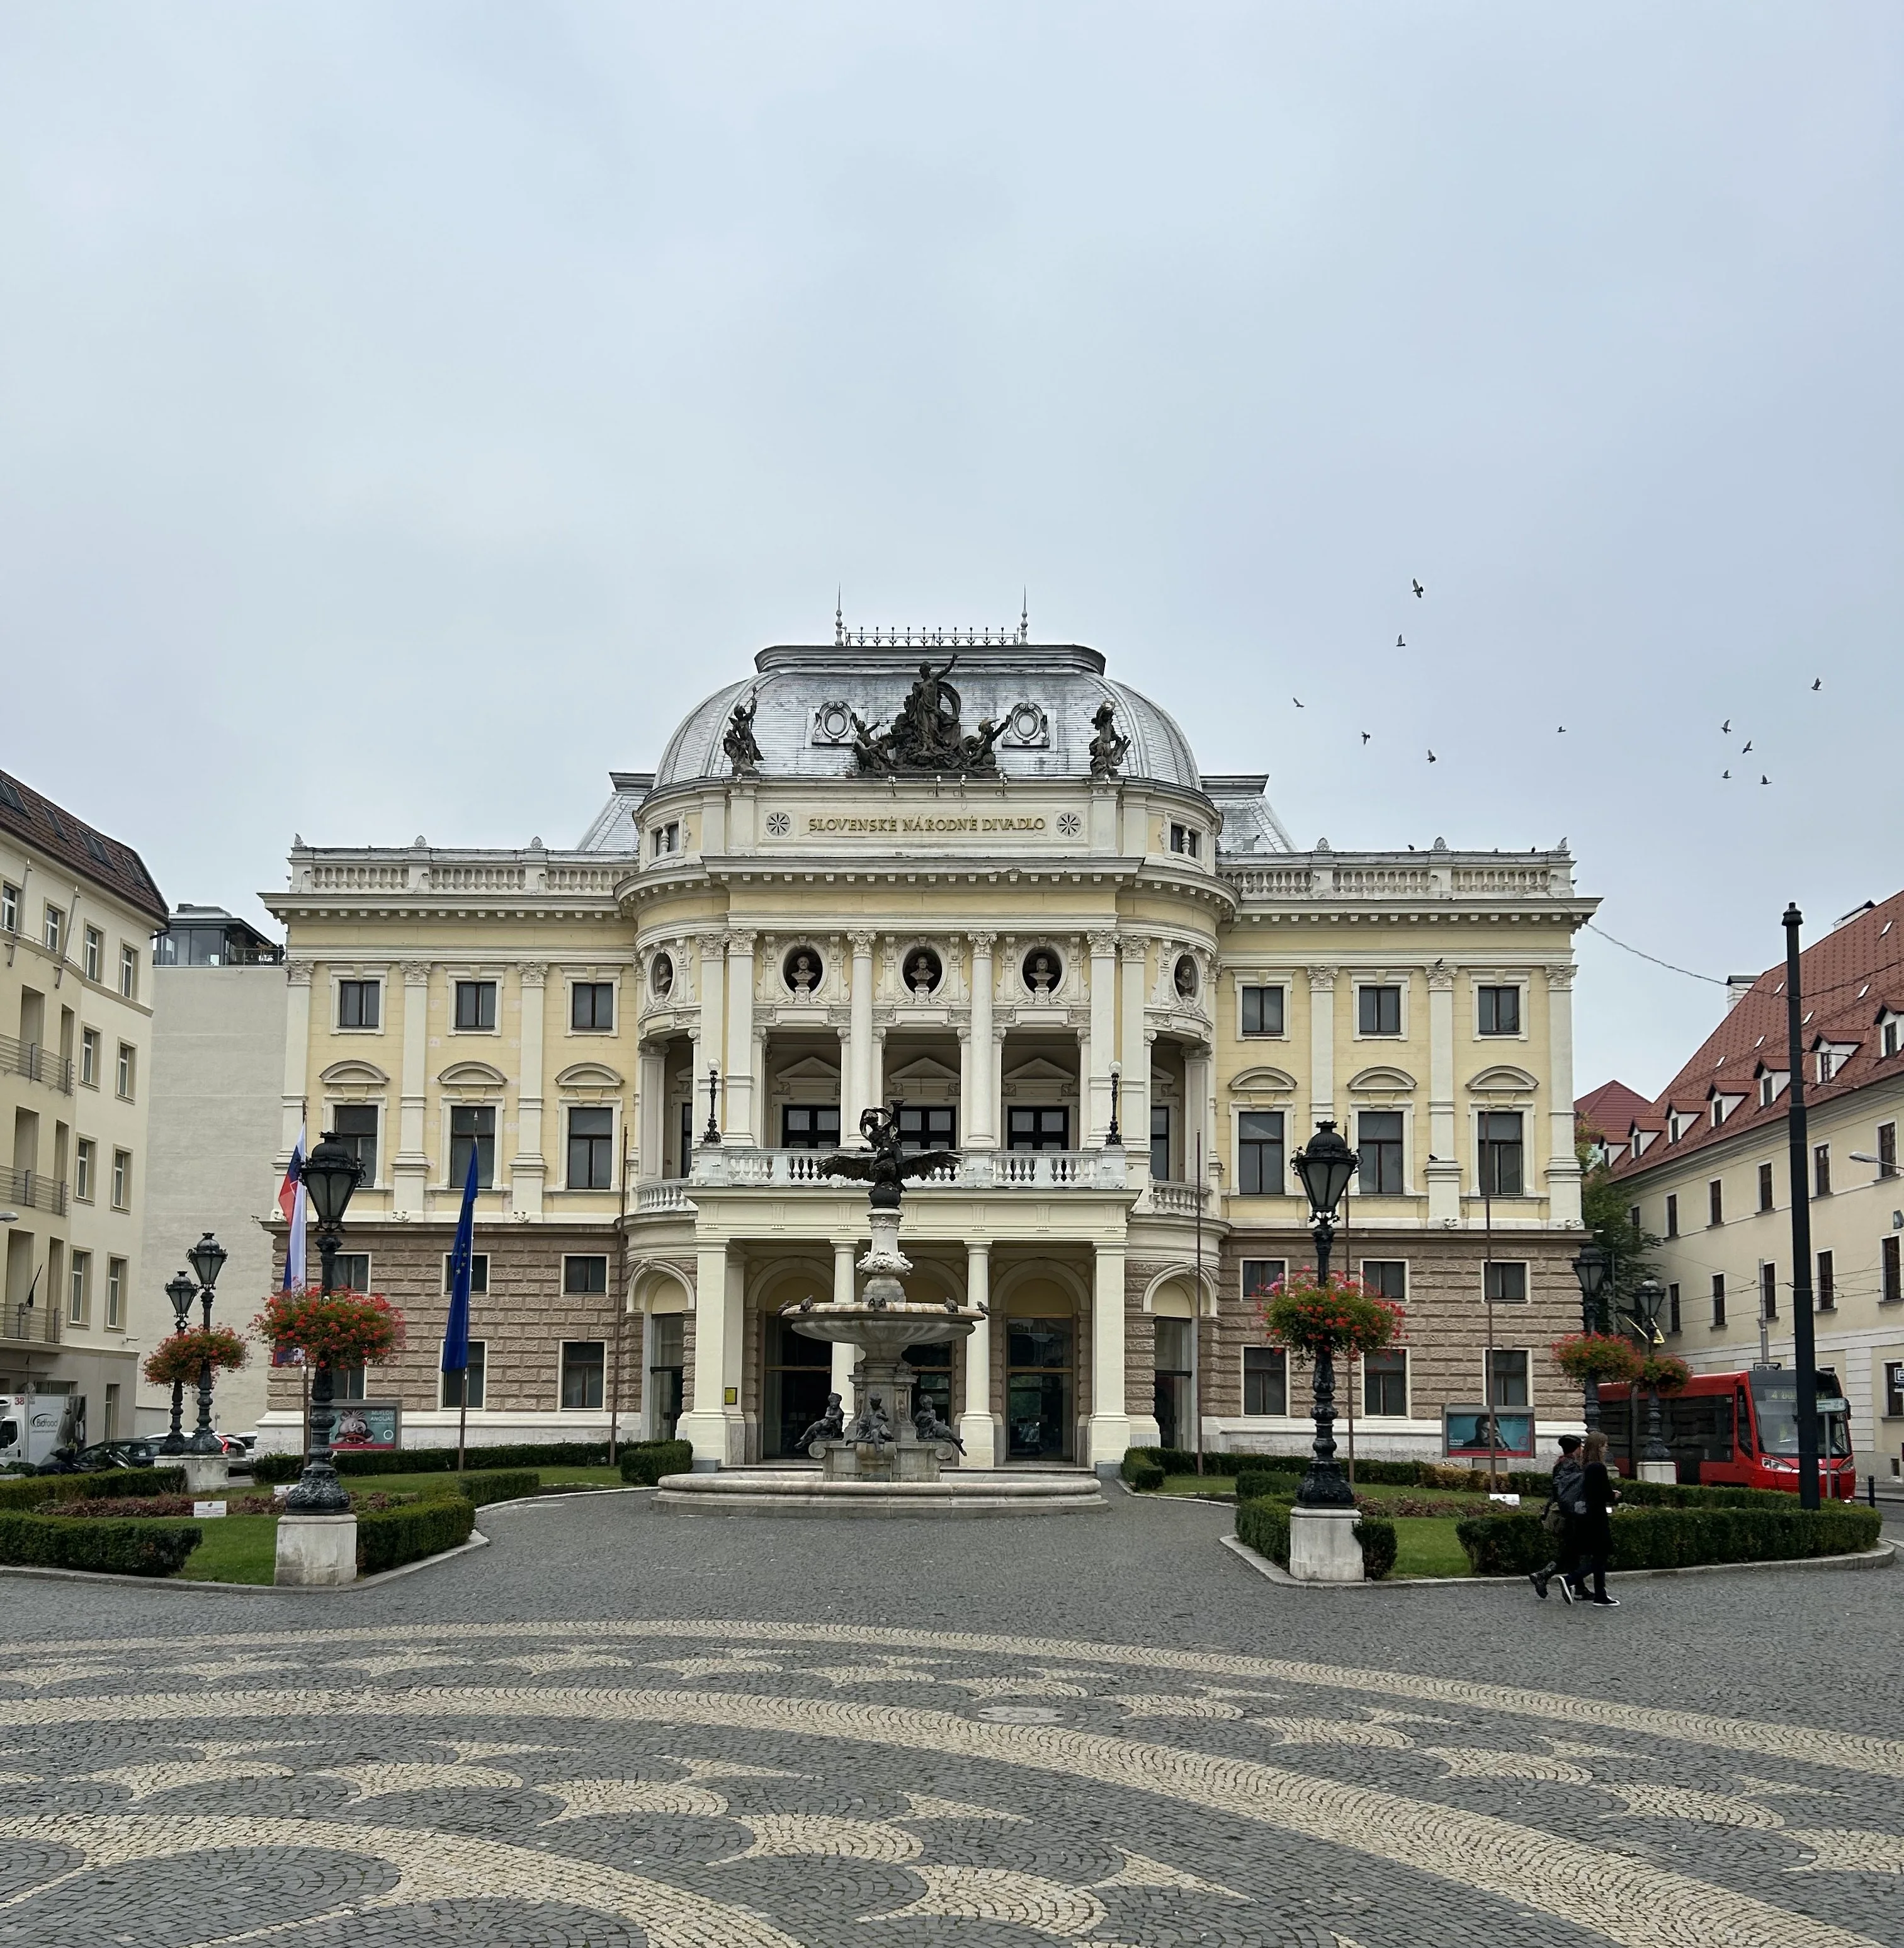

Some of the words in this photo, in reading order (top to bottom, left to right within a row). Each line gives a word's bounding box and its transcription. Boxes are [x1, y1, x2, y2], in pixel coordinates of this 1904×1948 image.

[808, 816, 897, 832] SLOVENSKÉ
[903, 815, 977, 831] NÁRODNÉ
[982, 818, 1046, 831] DIVADLO
[14, 1396, 25, 1405] 38
